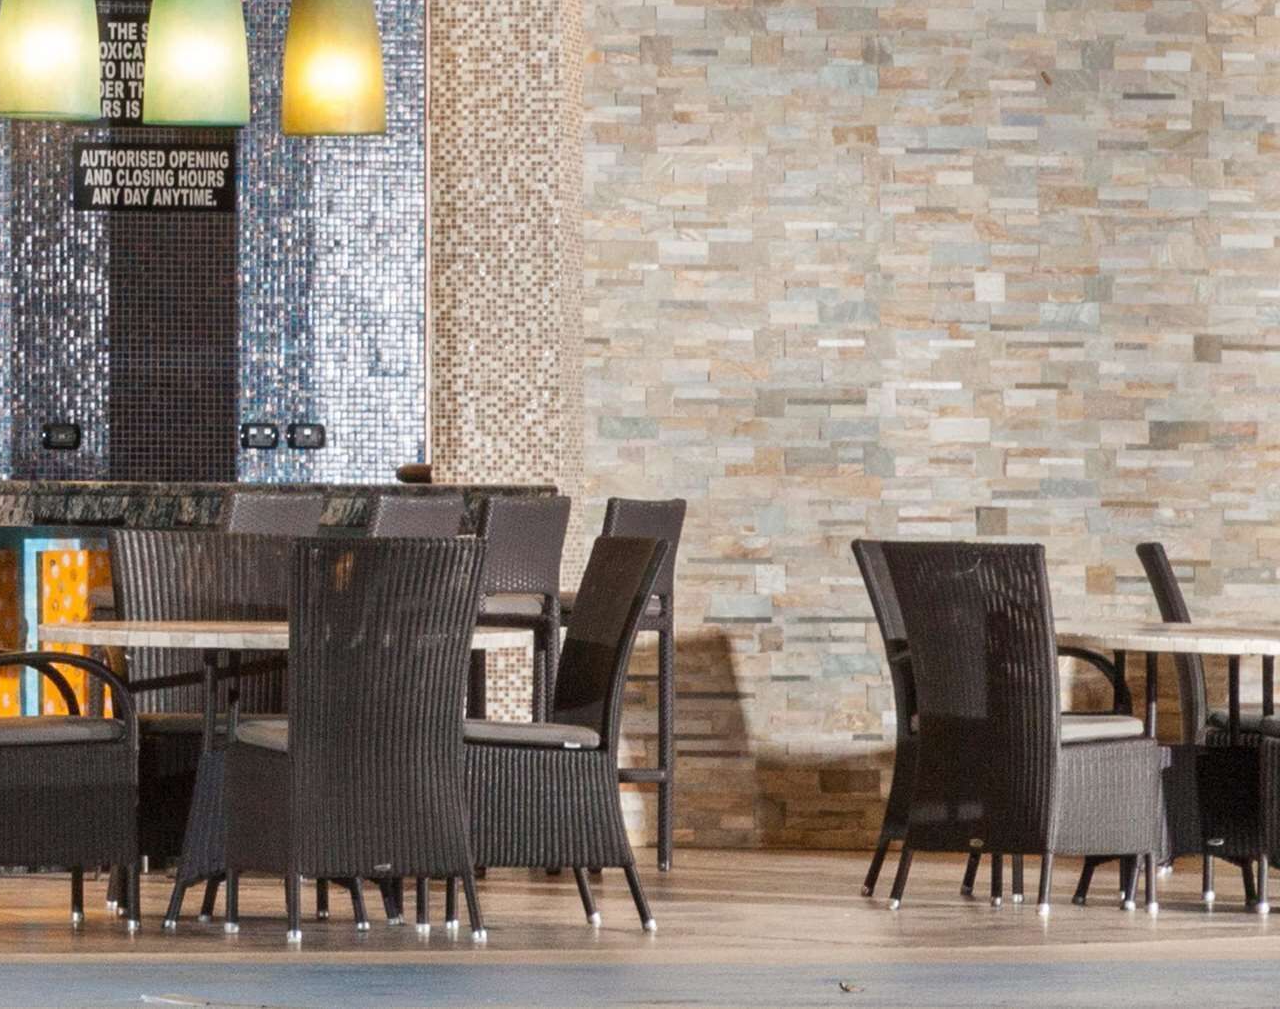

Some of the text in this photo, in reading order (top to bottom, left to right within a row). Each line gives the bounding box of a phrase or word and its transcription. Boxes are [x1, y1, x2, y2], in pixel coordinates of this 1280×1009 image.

[107, 22, 138, 40] THE
[125, 100, 140, 118] IS
[79, 149, 230, 169] AUTHORISED OPENING
[84, 169, 225, 187] AND CLOSING HOURS
[92, 188, 217, 206] ANY DAY ANYTIME.
